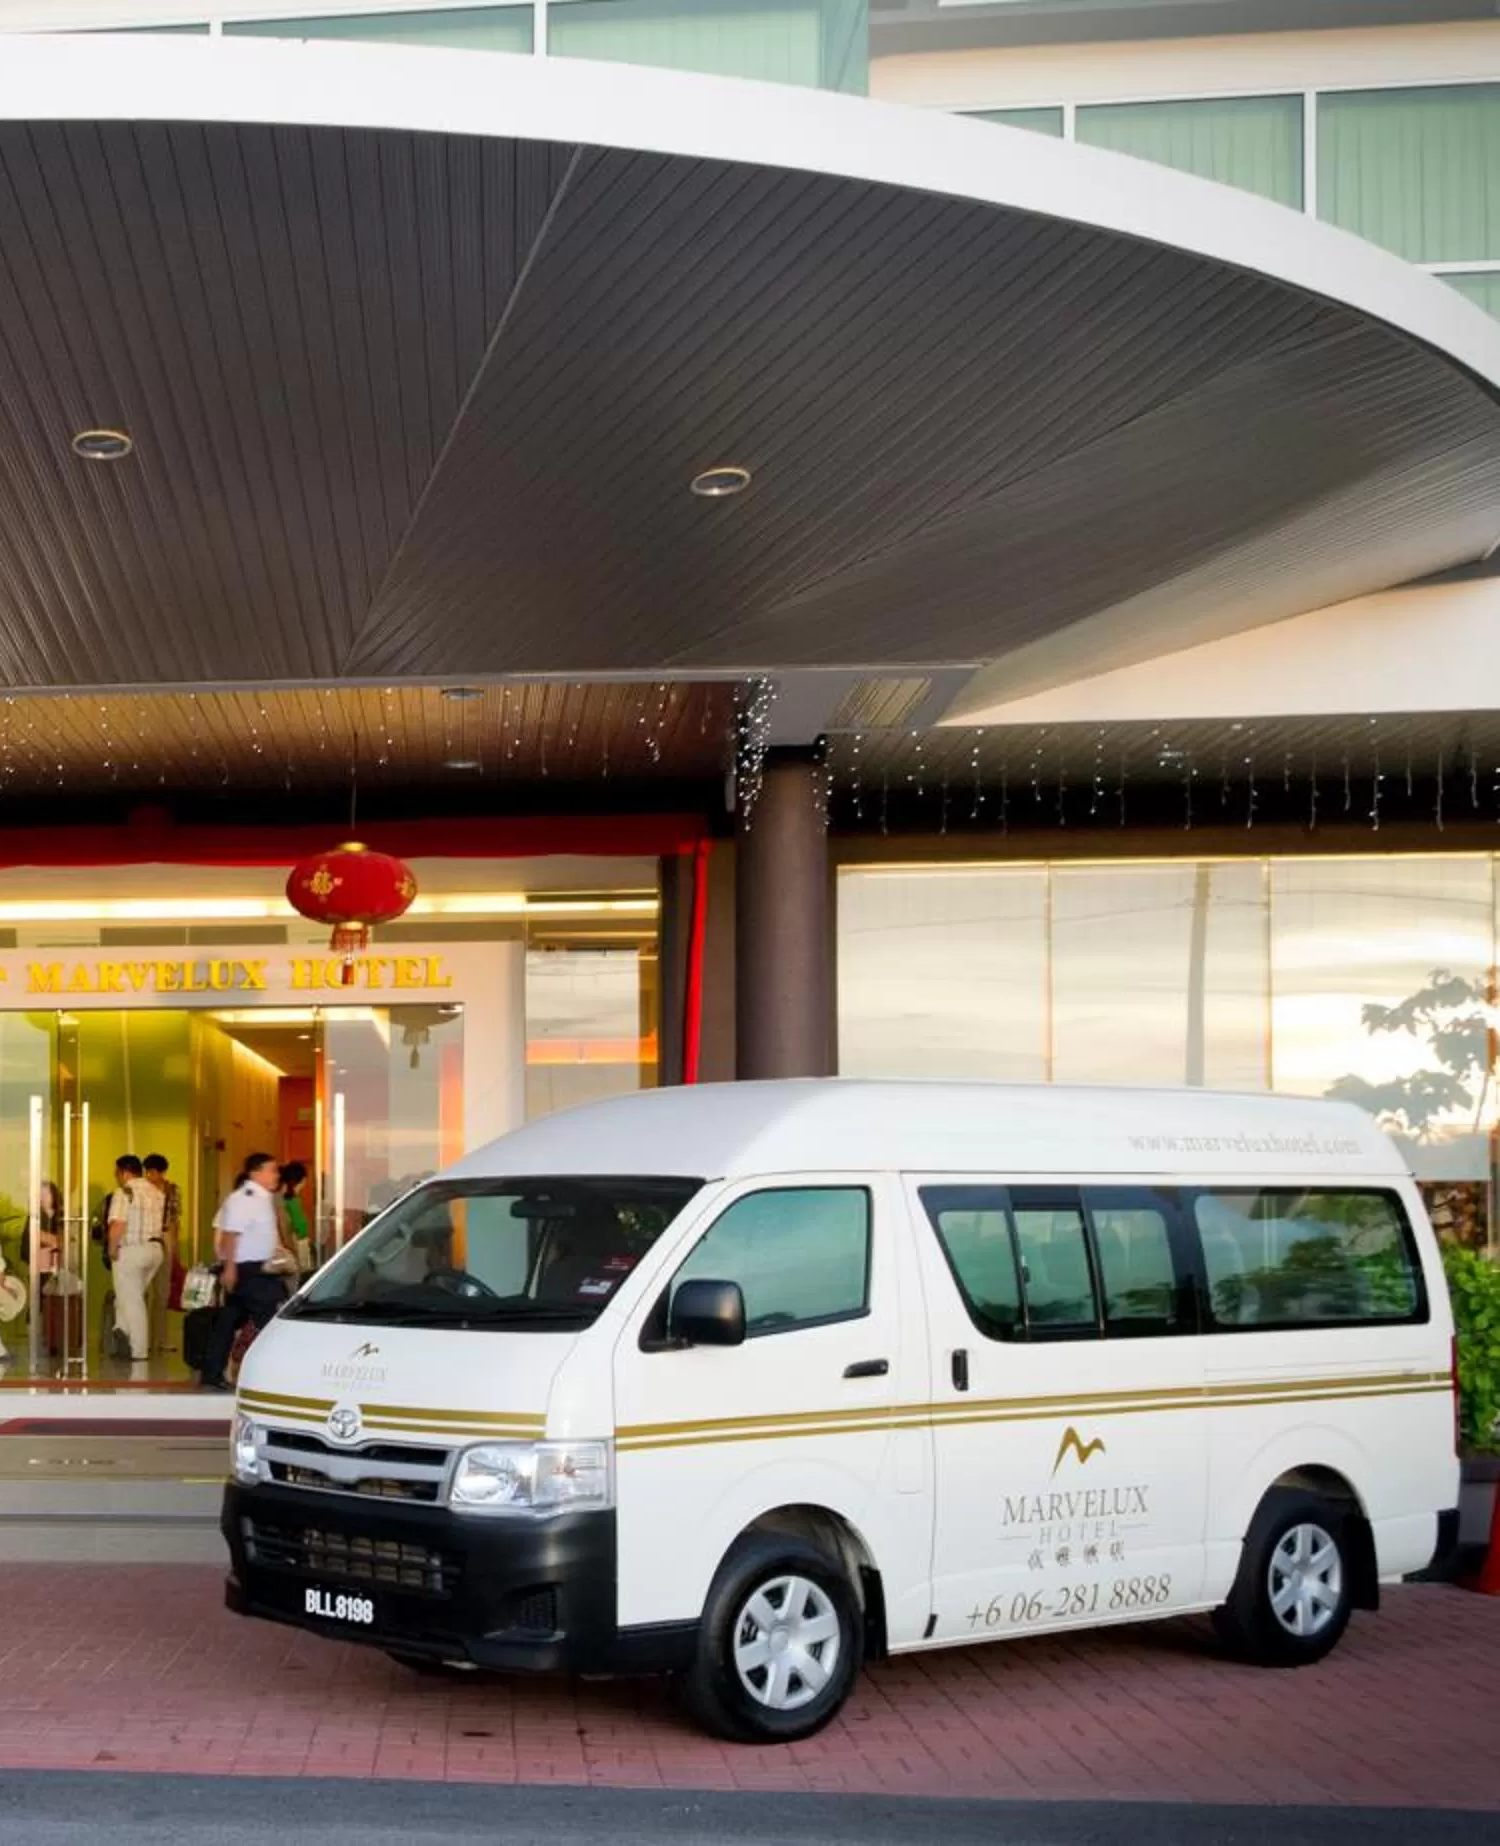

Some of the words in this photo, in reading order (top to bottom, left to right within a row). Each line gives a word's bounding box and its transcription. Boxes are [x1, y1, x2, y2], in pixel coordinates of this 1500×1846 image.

[27, 958, 268, 993] MARVELUX
[290, 954, 452, 990] HOTEL
[1002, 1485, 1150, 1526] MARVELUX
[1039, 1520, 1118, 1545] HOTEL
[305, 1588, 373, 1625] BLL8198
[966, 1593, 1003, 1628] +6
[1010, 1583, 1100, 1623] 06-281
[1109, 1573, 1171, 1609] 8888
